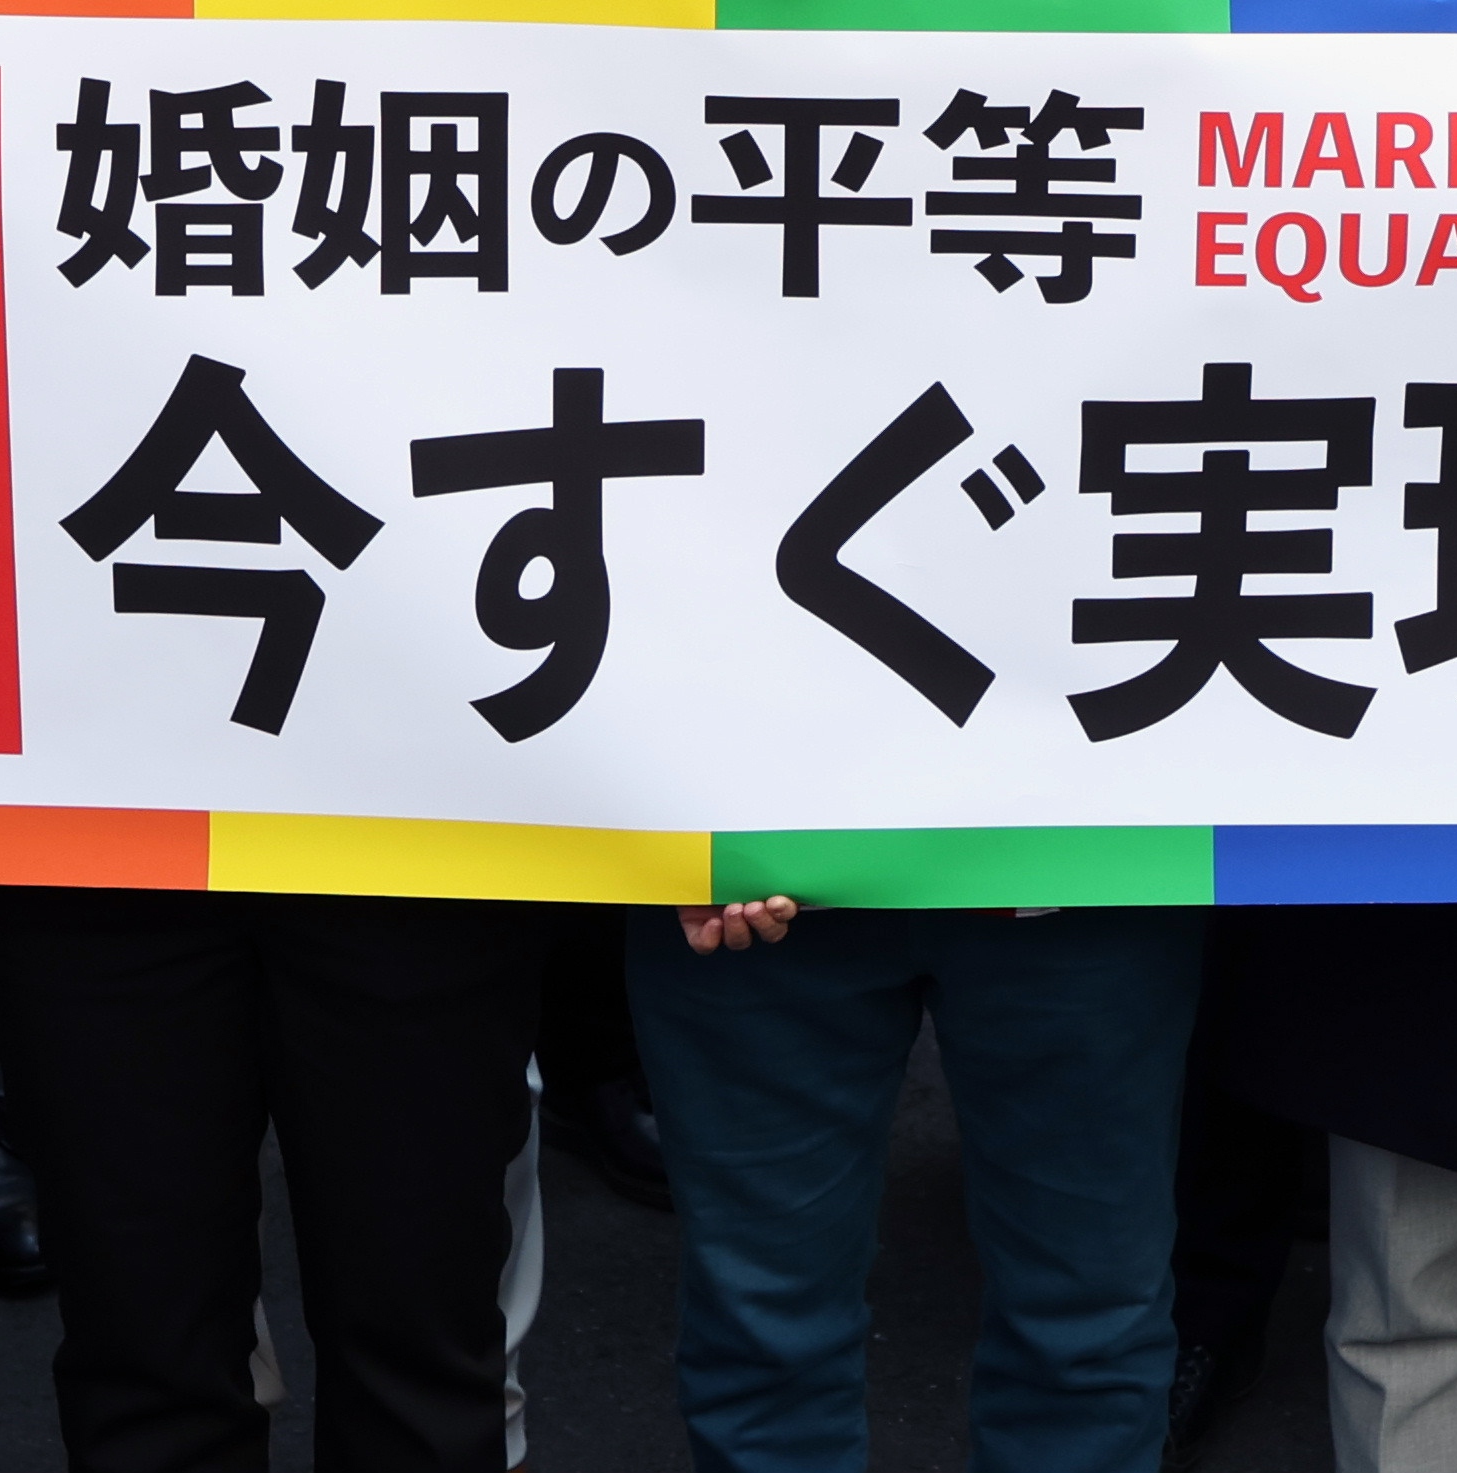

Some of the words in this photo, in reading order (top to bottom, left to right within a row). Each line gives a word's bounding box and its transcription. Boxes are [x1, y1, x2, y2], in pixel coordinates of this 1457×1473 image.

[56, 76, 1145, 304] 婚姻の平等
